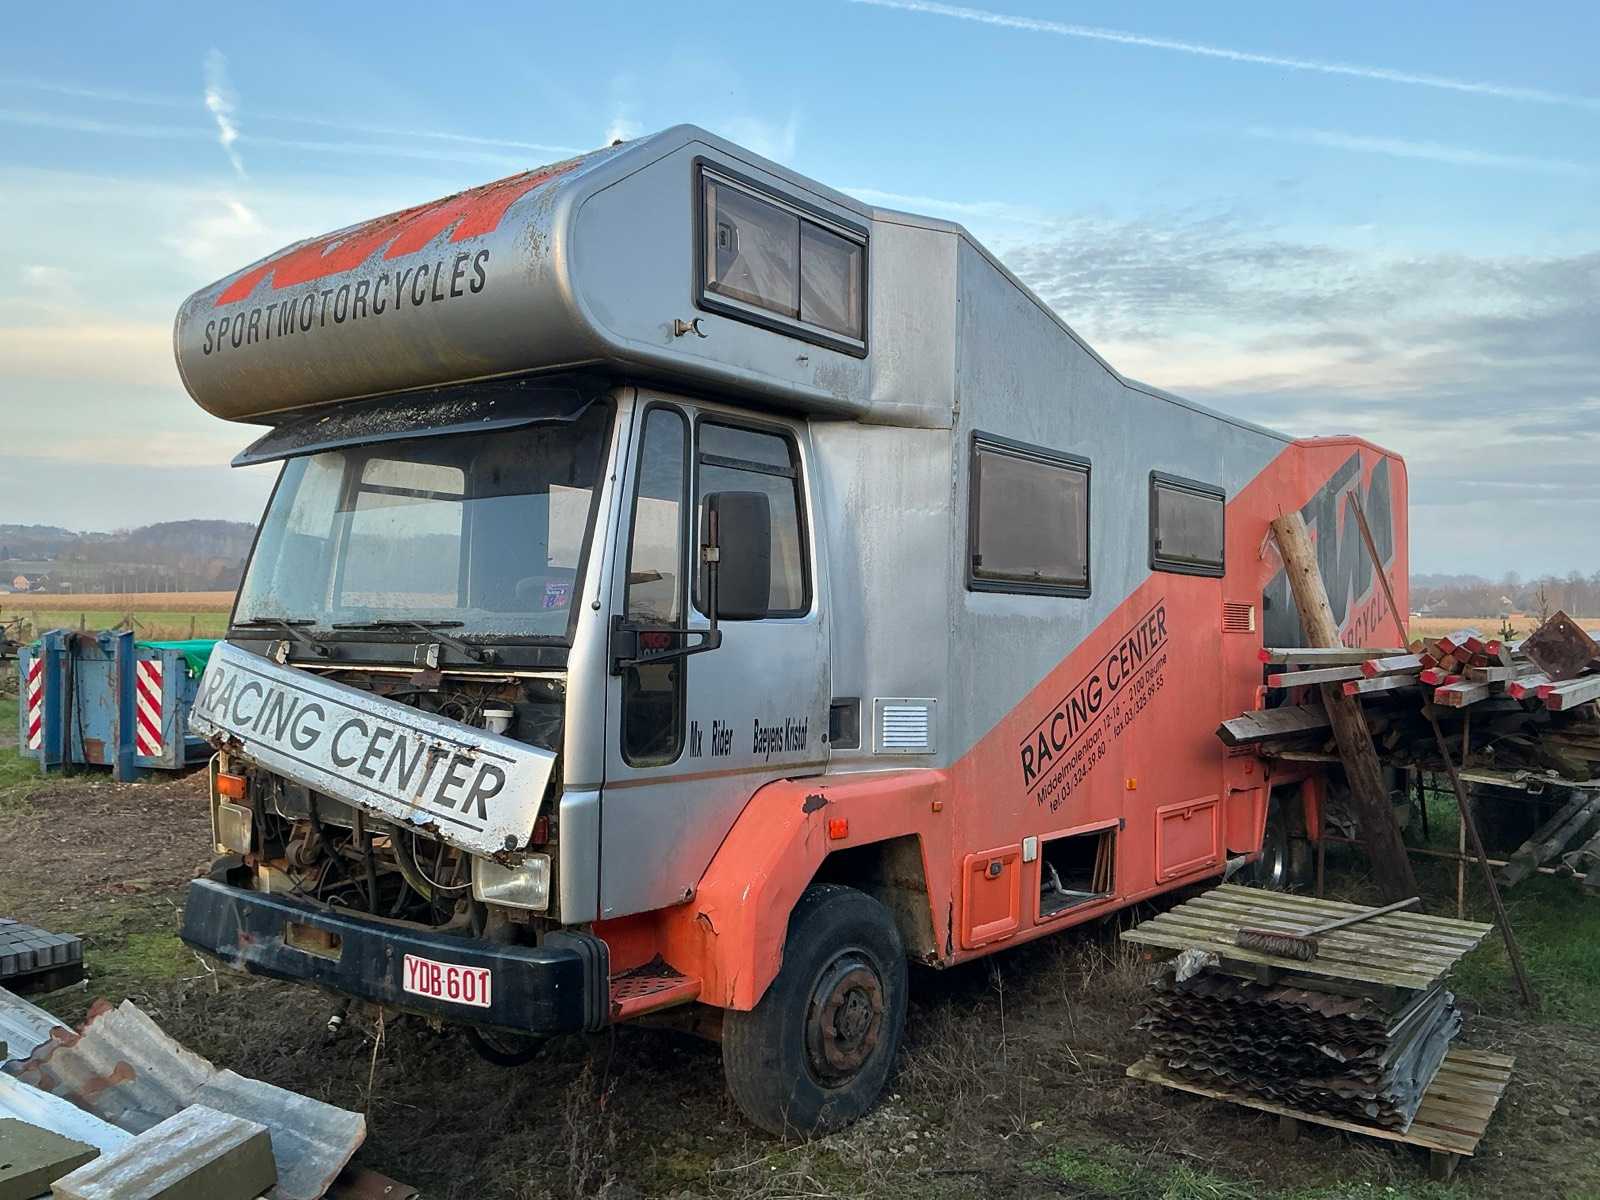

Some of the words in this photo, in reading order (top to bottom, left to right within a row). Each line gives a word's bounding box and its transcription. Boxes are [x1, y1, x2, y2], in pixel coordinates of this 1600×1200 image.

[203, 248, 490, 355] SPORTMOTORCYCLES
[202, 667, 325, 751] RACING
[331, 718, 506, 820] CENTER
[690, 720, 703, 757] Mx
[712, 719, 733, 757] Rider
[753, 718, 783, 762] Baeyens
[784, 716, 808, 752] Kristof
[1021, 676, 1103, 786] RACING
[1107, 606, 1168, 691] CENTER
[1037, 728, 1103, 806] Middelmolenlaan
[1129, 676, 1145, 701] 2100
